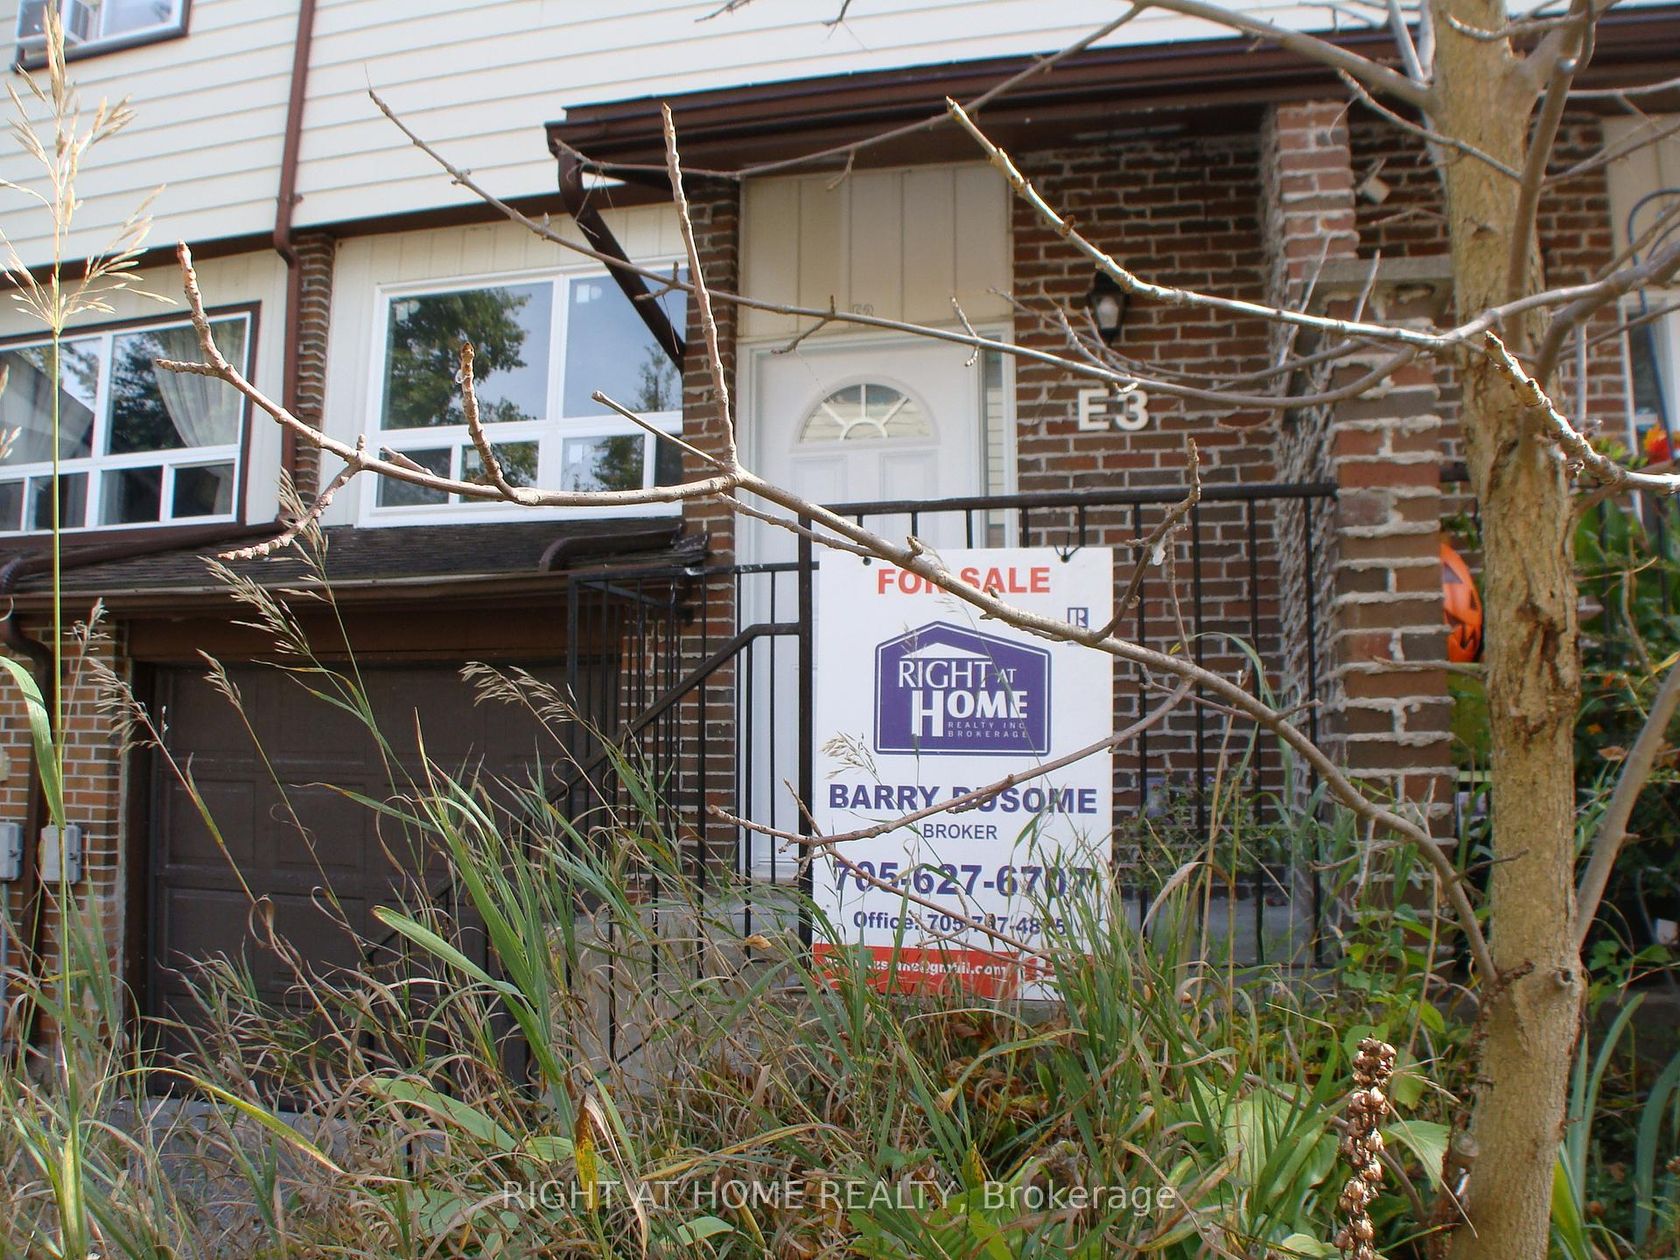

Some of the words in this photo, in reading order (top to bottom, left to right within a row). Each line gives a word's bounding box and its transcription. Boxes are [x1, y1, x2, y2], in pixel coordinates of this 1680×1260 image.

[1078, 388, 1149, 431] E3
[960, 566, 1051, 594] SALE
[899, 660, 993, 689] RIGHT
[998, 668, 1017, 684] AT
[912, 689, 1029, 738] HOME
[947, 721, 995, 730] REALTY
[947, 730, 1028, 739] BROKERAGE
[829, 783, 940, 811] BARRY
[923, 823, 998, 841] BROKER
